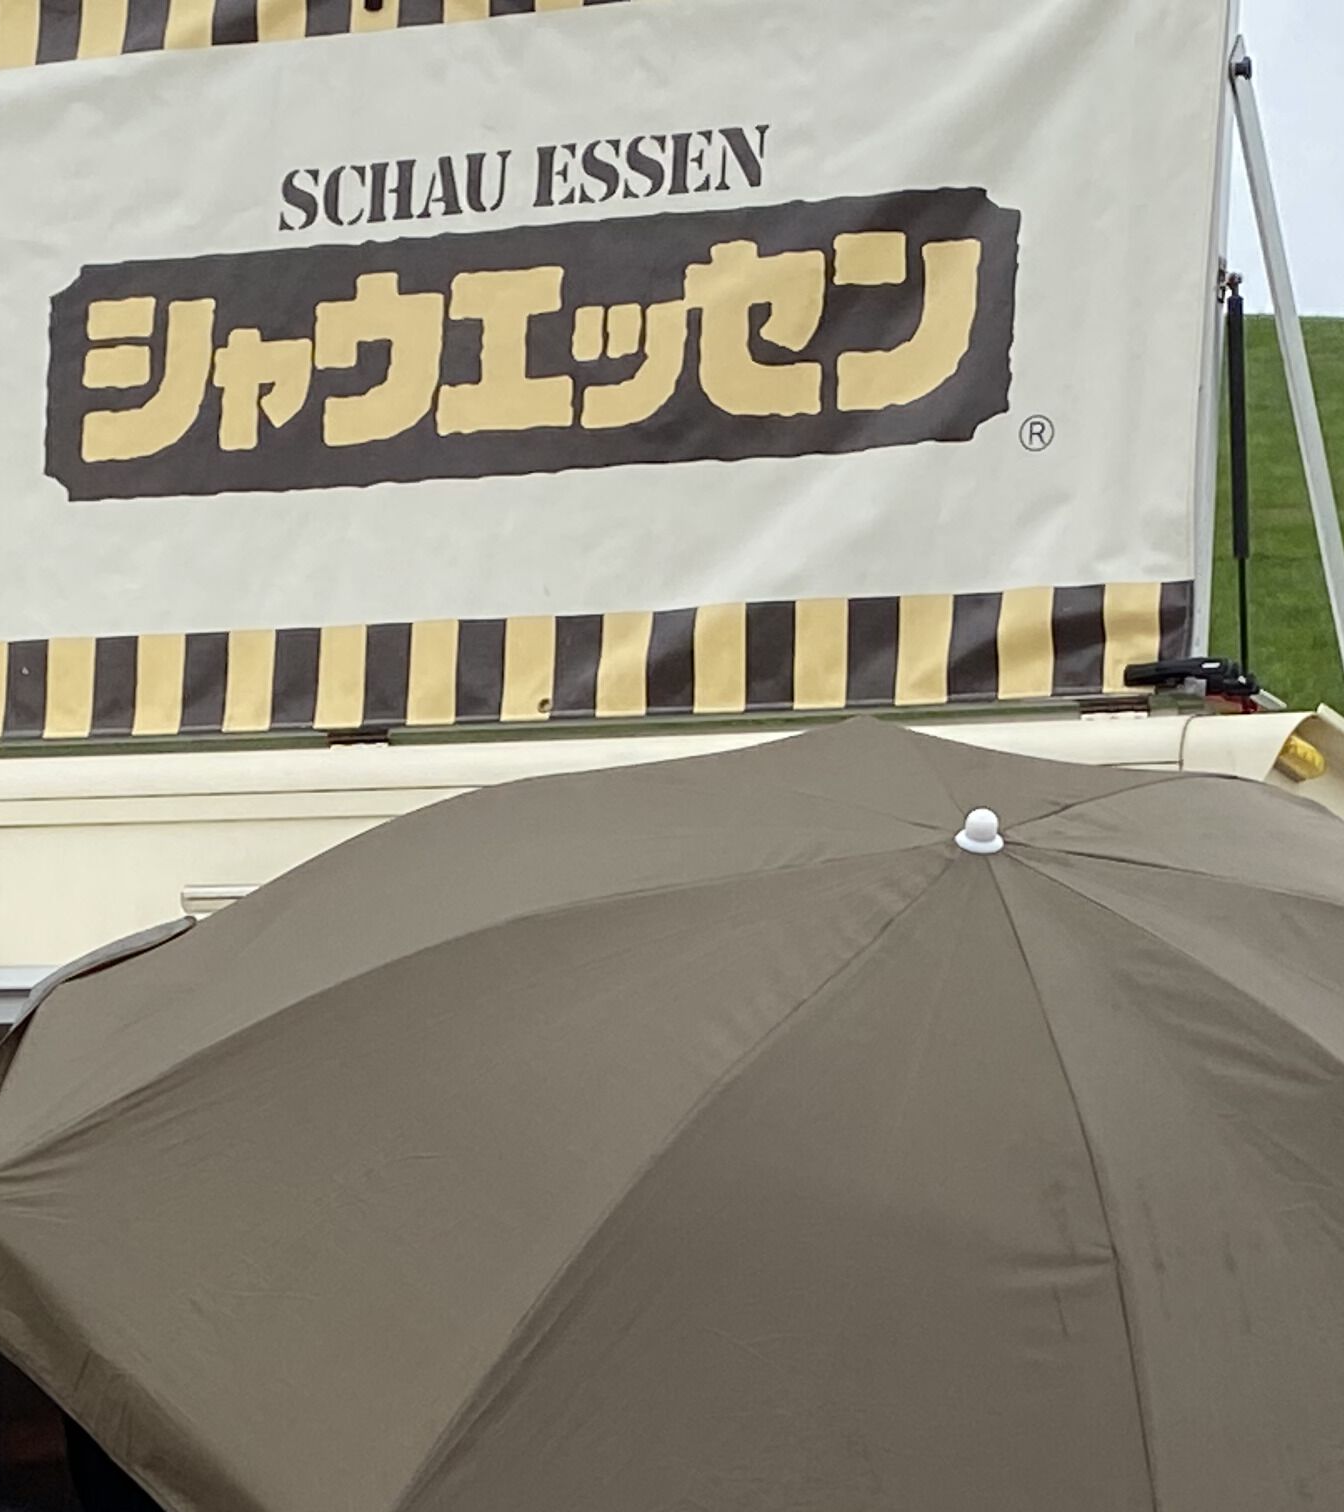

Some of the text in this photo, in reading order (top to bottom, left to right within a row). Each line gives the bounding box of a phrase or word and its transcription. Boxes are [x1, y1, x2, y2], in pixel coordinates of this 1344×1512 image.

[278, 125, 769, 231] SCHAU ESSEN
[81, 231, 981, 462] シャウエッセン
